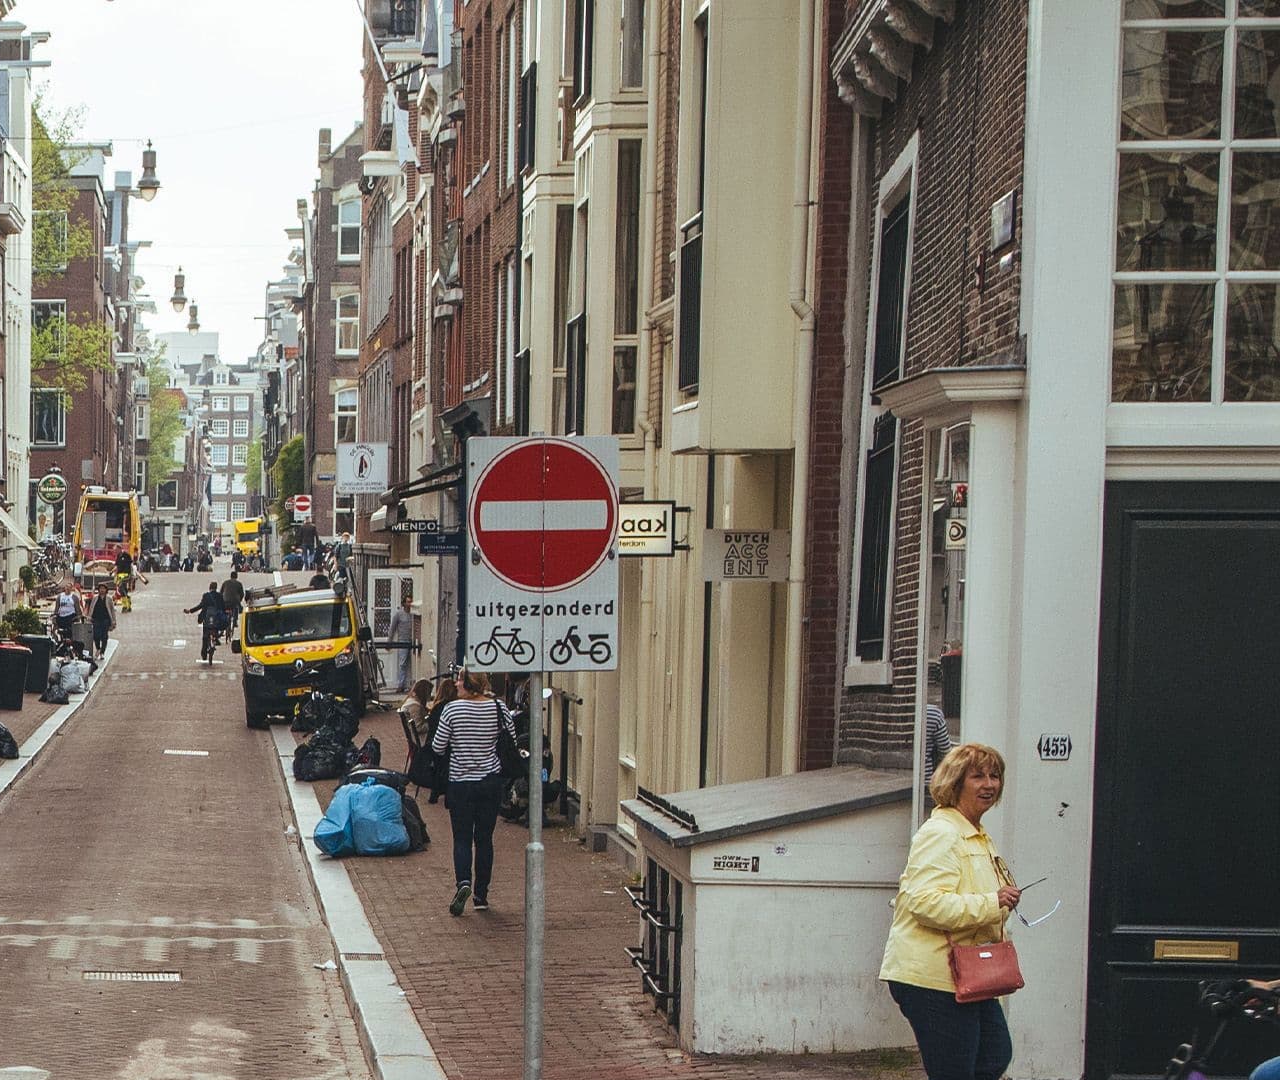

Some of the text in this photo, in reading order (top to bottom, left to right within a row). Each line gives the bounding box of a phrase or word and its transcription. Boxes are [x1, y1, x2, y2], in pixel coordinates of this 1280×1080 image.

[391, 522, 436, 531] MENDO
[724, 534, 770, 543] DUTCH
[725, 544, 769, 559] ACC
[723, 560, 769, 575] ENT
[475, 600, 615, 621] uitgezonderd
[1042, 736, 1068, 757] 455
